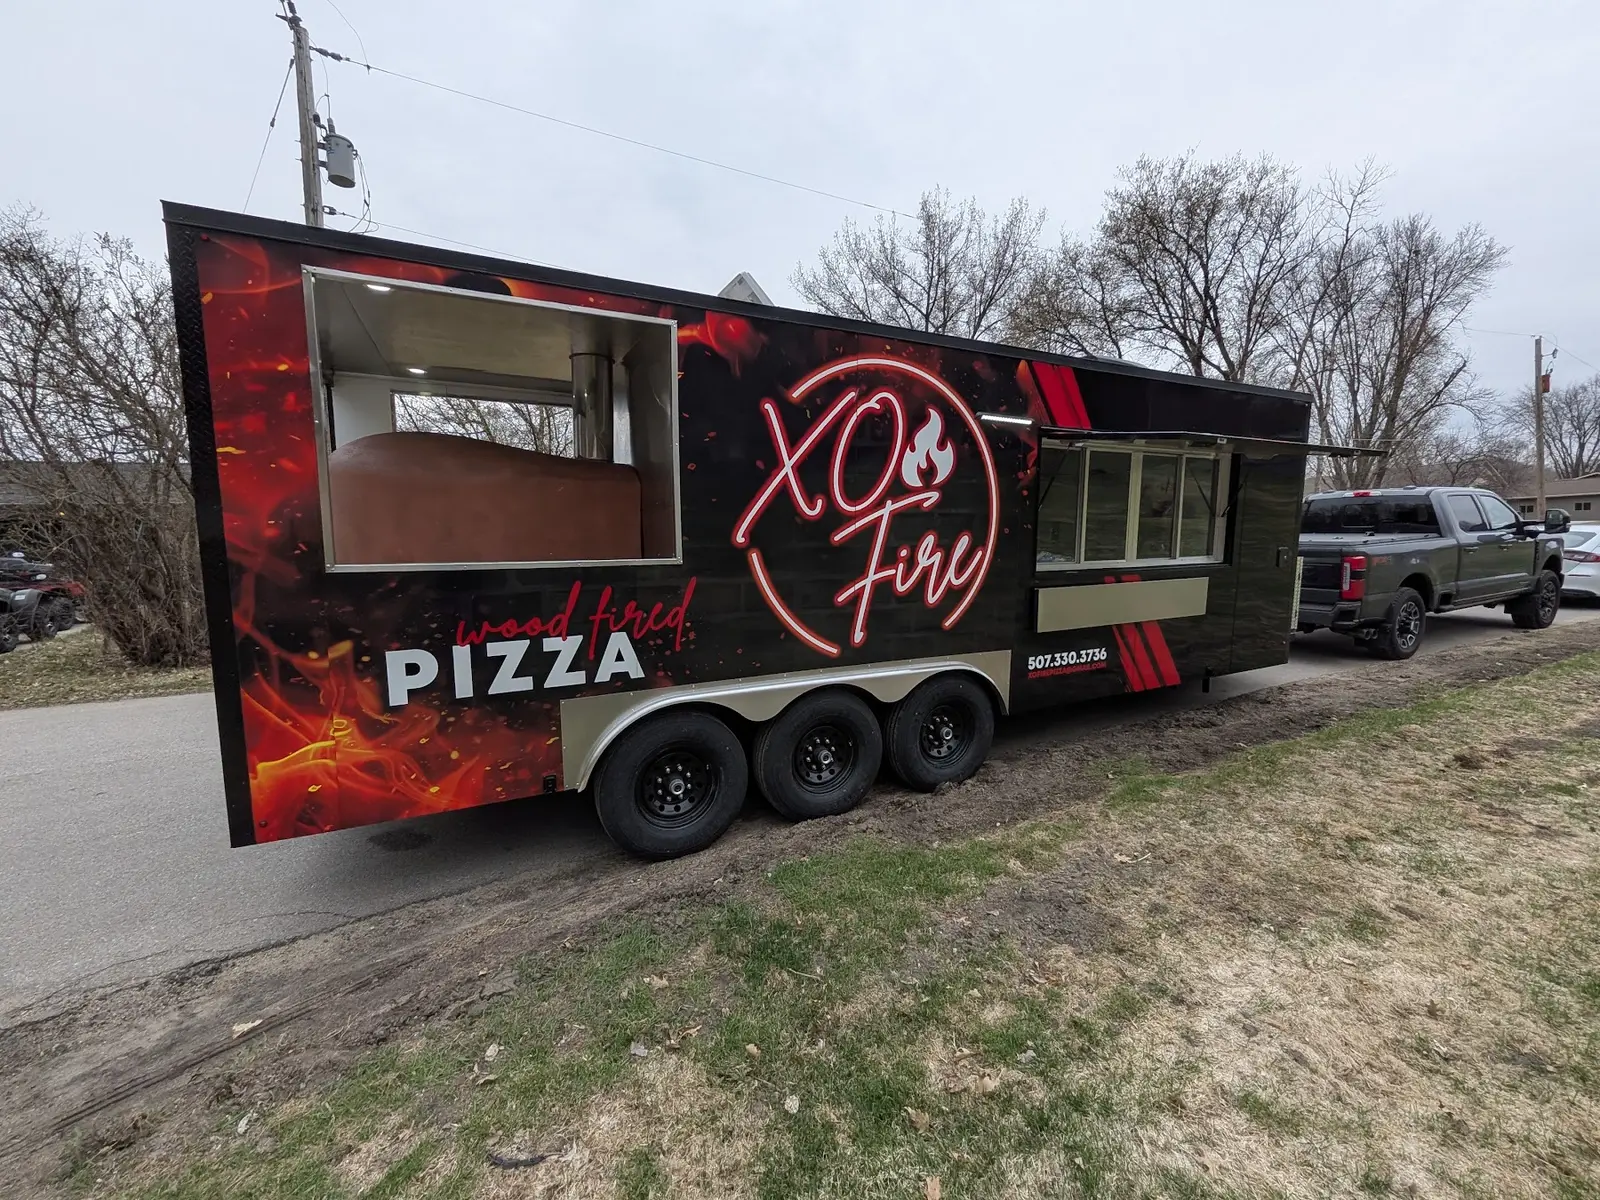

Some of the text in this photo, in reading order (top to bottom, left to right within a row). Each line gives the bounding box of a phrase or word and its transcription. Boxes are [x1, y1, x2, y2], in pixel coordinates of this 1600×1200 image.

[734, 389, 905, 544] XO
[832, 490, 984, 645] Fire
[456, 576, 696, 660] wood fired
[1028, 648, 1108, 670] 507.330.3736
[385, 632, 645, 708] PIZZA
